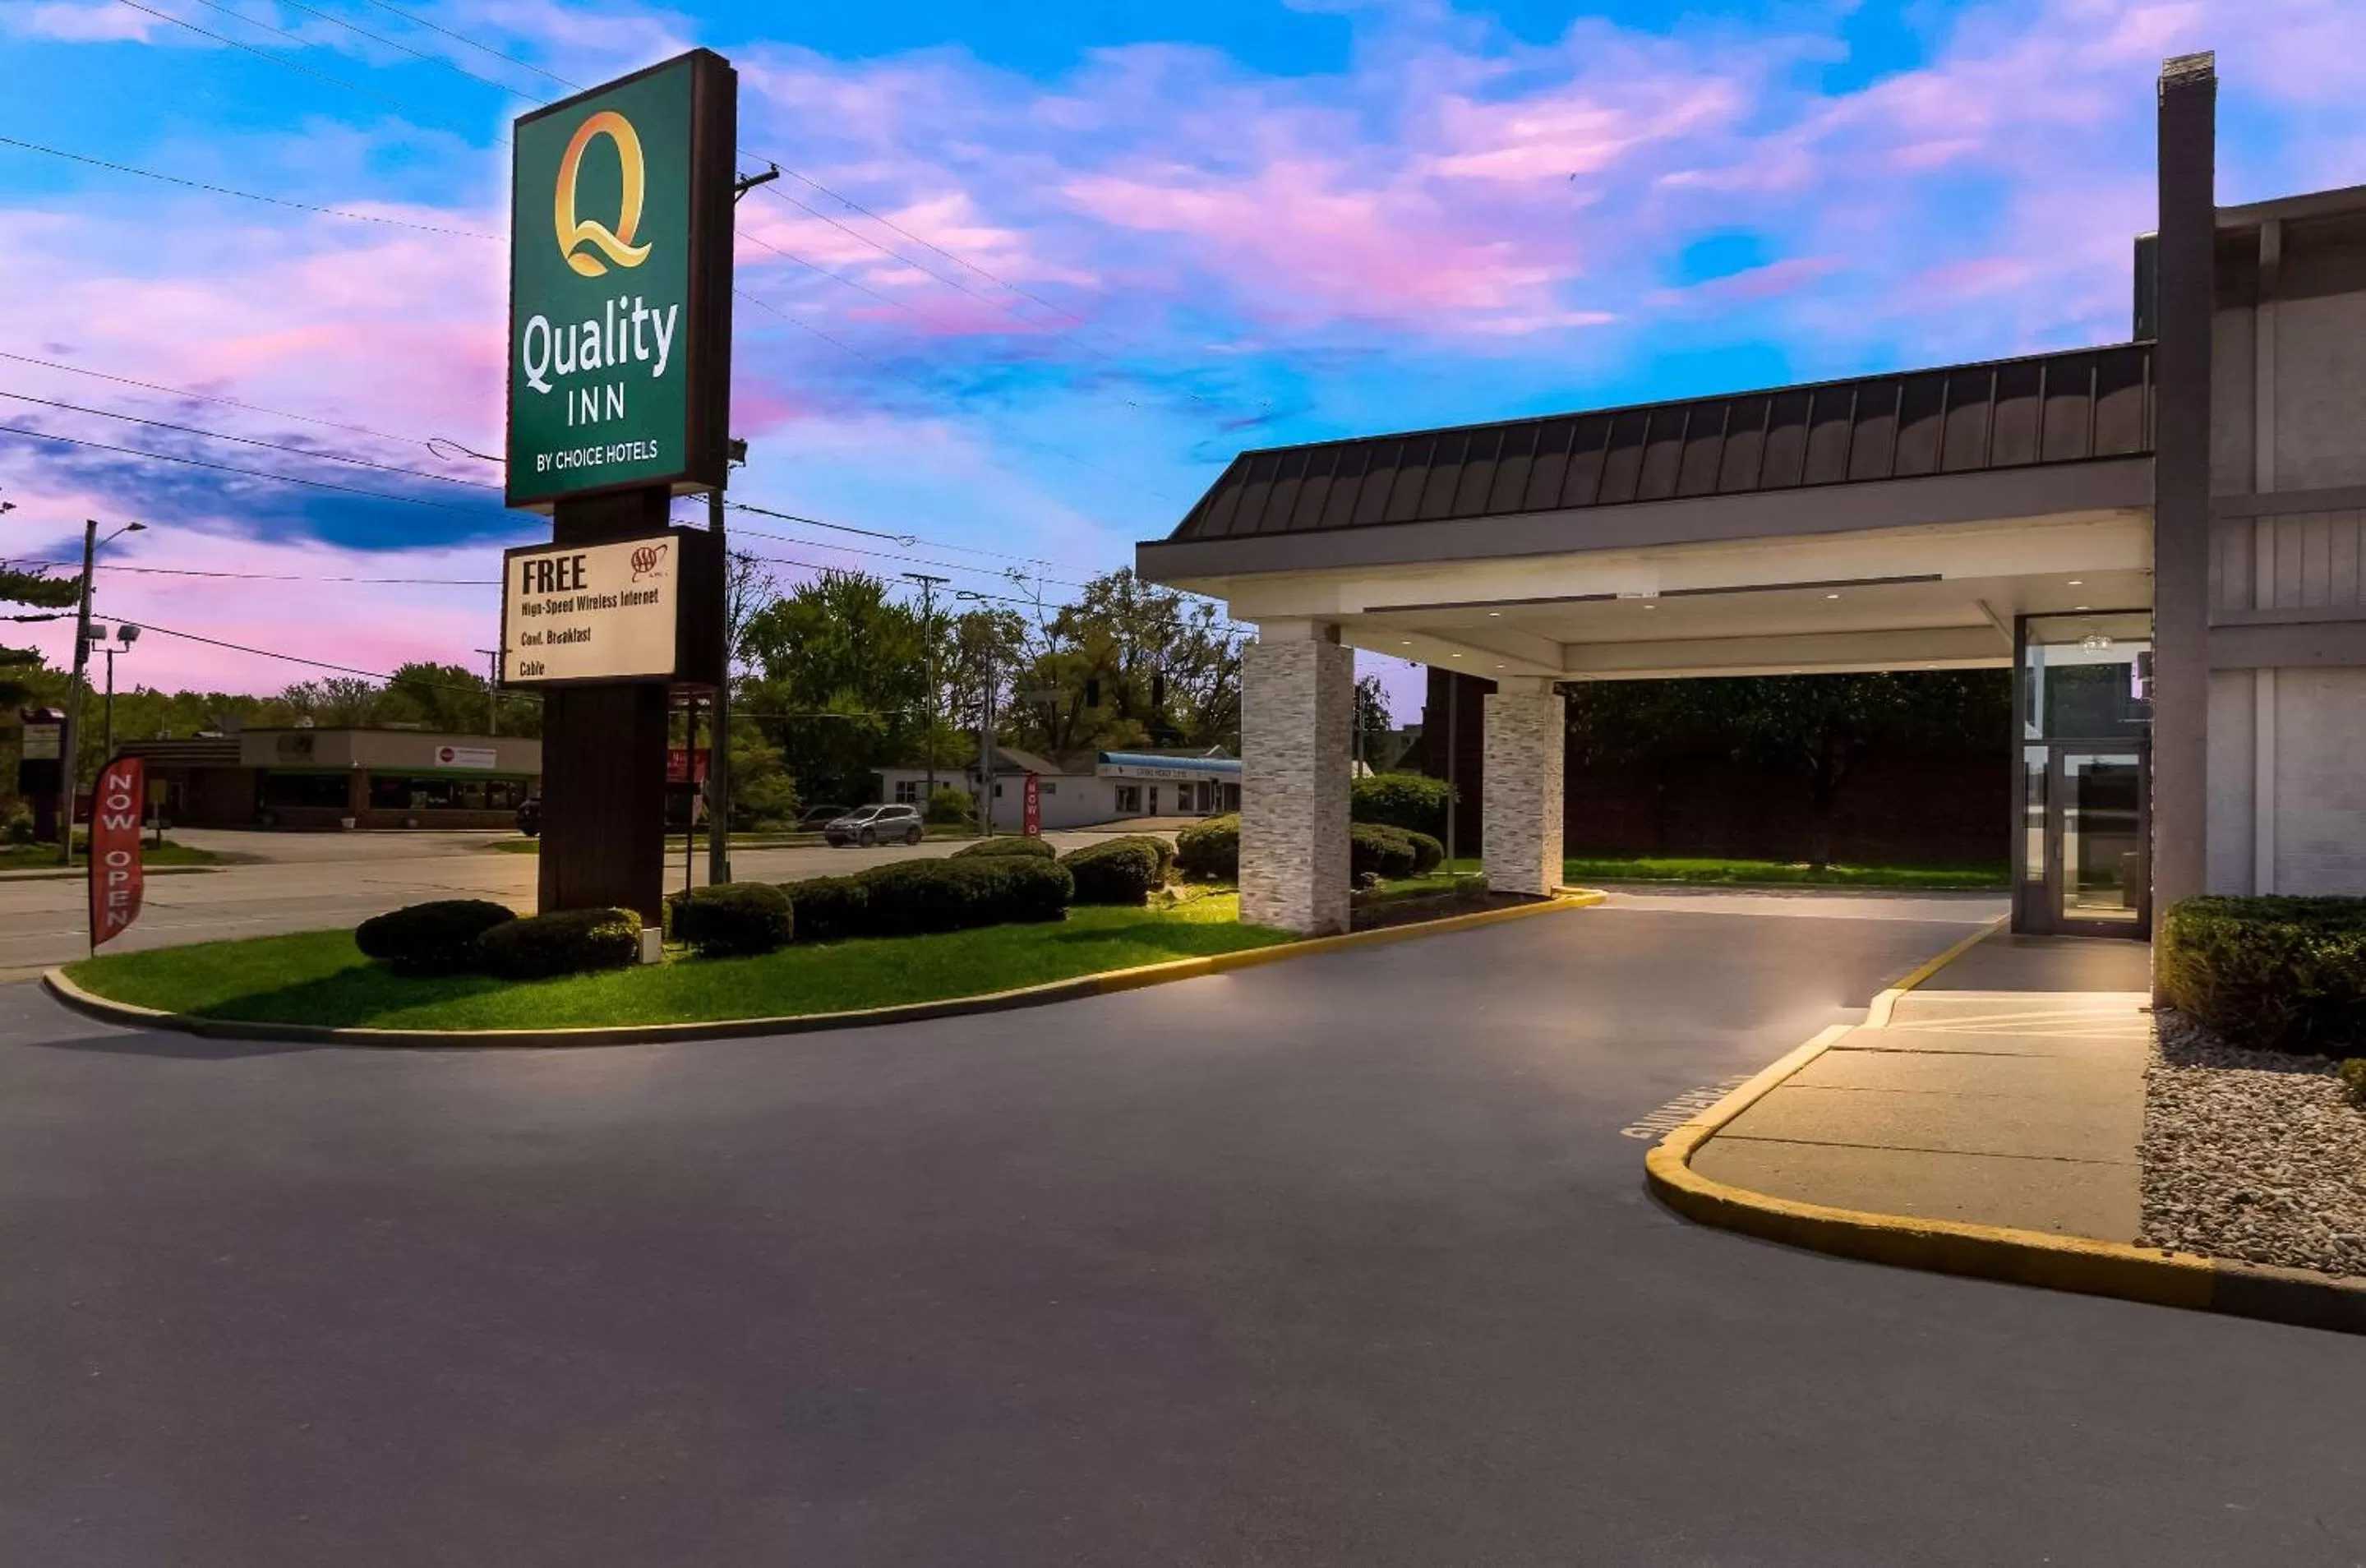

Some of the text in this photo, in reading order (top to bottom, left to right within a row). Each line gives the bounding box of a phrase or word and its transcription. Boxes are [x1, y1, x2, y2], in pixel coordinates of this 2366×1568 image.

[555, 110, 653, 278] Q
[523, 295, 678, 394] Quality
[568, 381, 625, 427] INN
[537, 440, 657, 472] BY CHOICE HOTELS
[522, 554, 588, 596] FREE
[521, 588, 660, 618] High-Speed Wireless Internet
[547, 626, 591, 645] Breakfast
[519, 661, 545, 676] Cable
[103, 774, 135, 927] NOW OPEN
